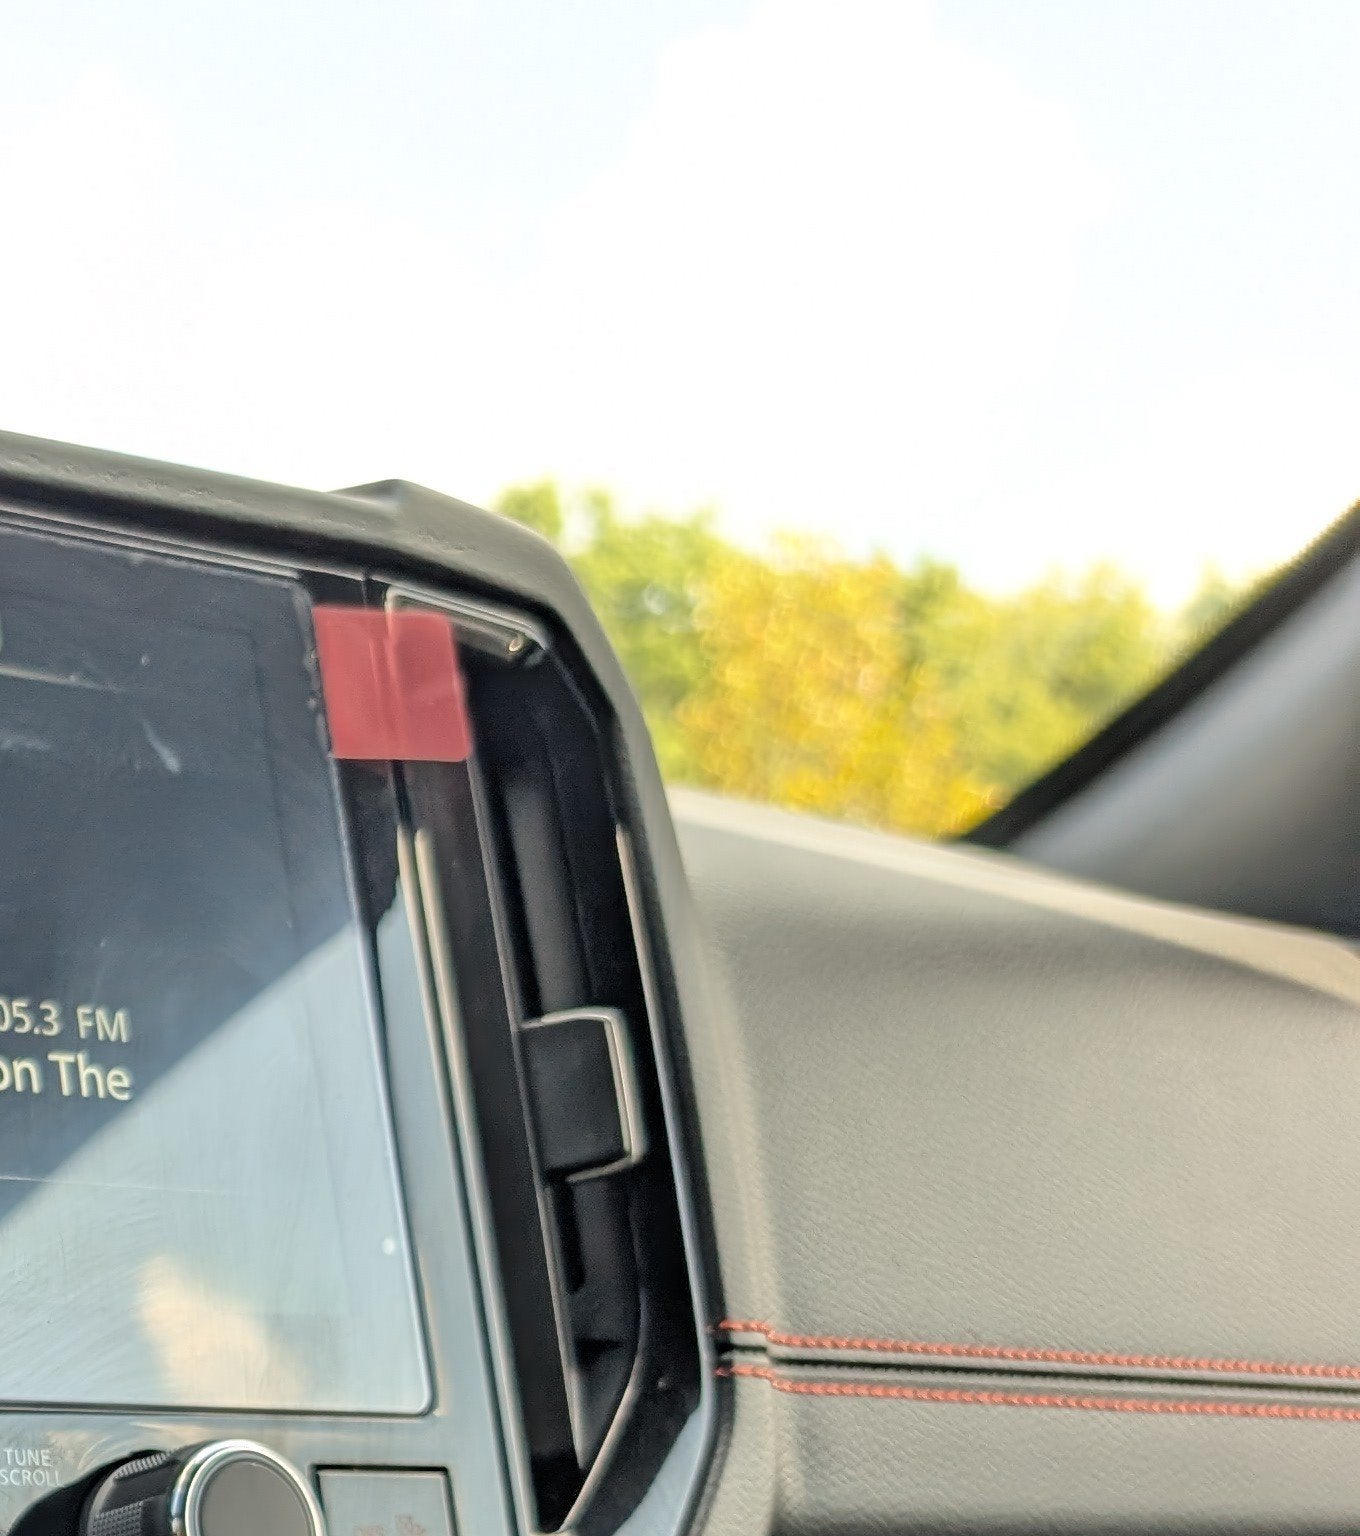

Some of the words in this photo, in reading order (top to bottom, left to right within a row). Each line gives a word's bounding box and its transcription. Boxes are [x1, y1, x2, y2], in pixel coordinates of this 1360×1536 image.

[78, 1005, 130, 1043] FM
[46, 1054, 132, 1102] The
[2, 1447, 53, 1467] TUNE
